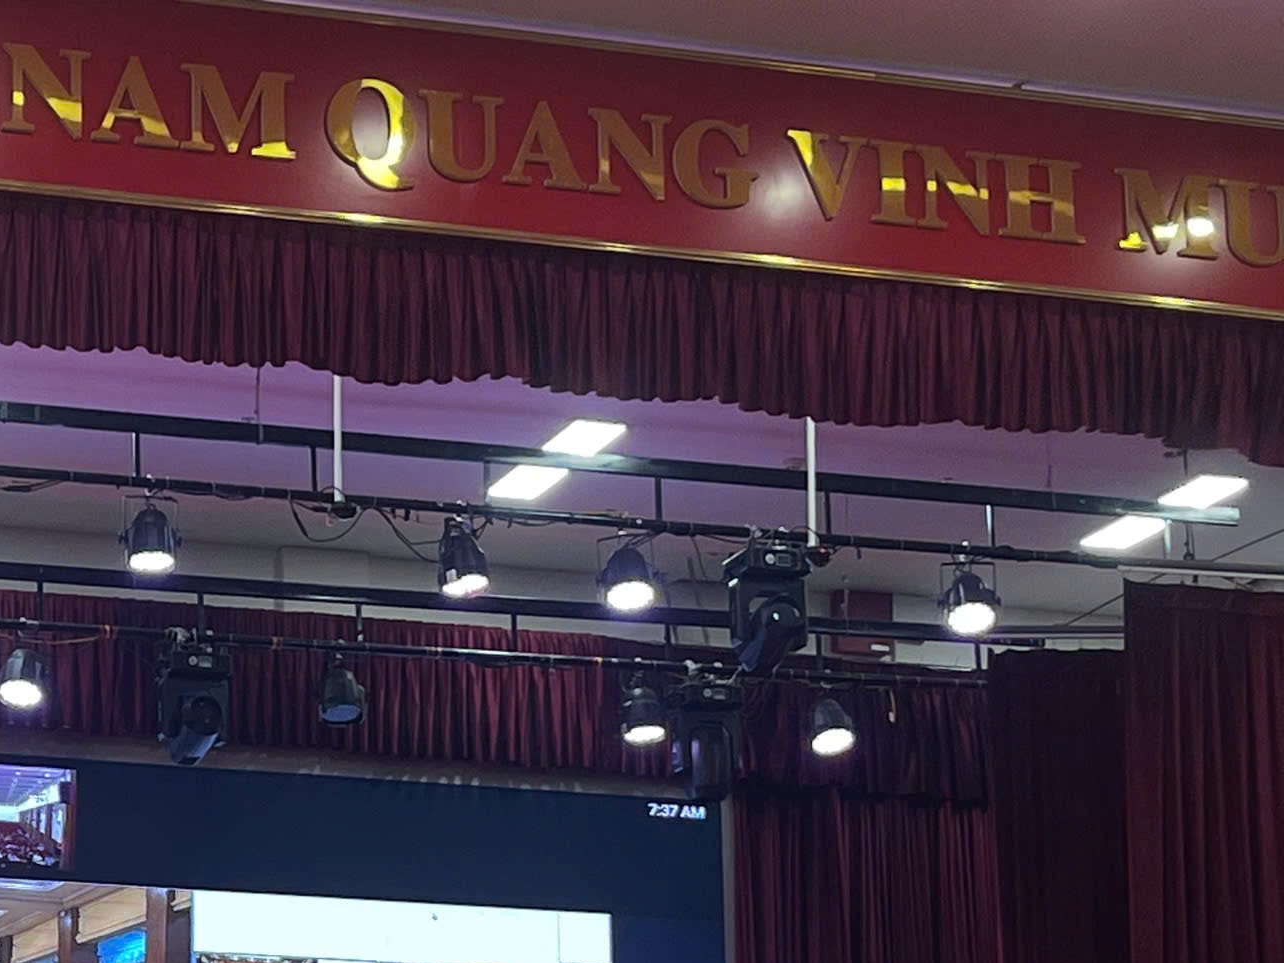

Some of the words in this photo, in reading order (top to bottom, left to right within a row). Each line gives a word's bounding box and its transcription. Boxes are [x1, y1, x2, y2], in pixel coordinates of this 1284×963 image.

[1, 42, 297, 160] NAM
[324, 77, 759, 209] QUANG
[786, 128, 1086, 245] VINH
[647, 803, 679, 818] 7:37
[680, 805, 706, 820] AM
